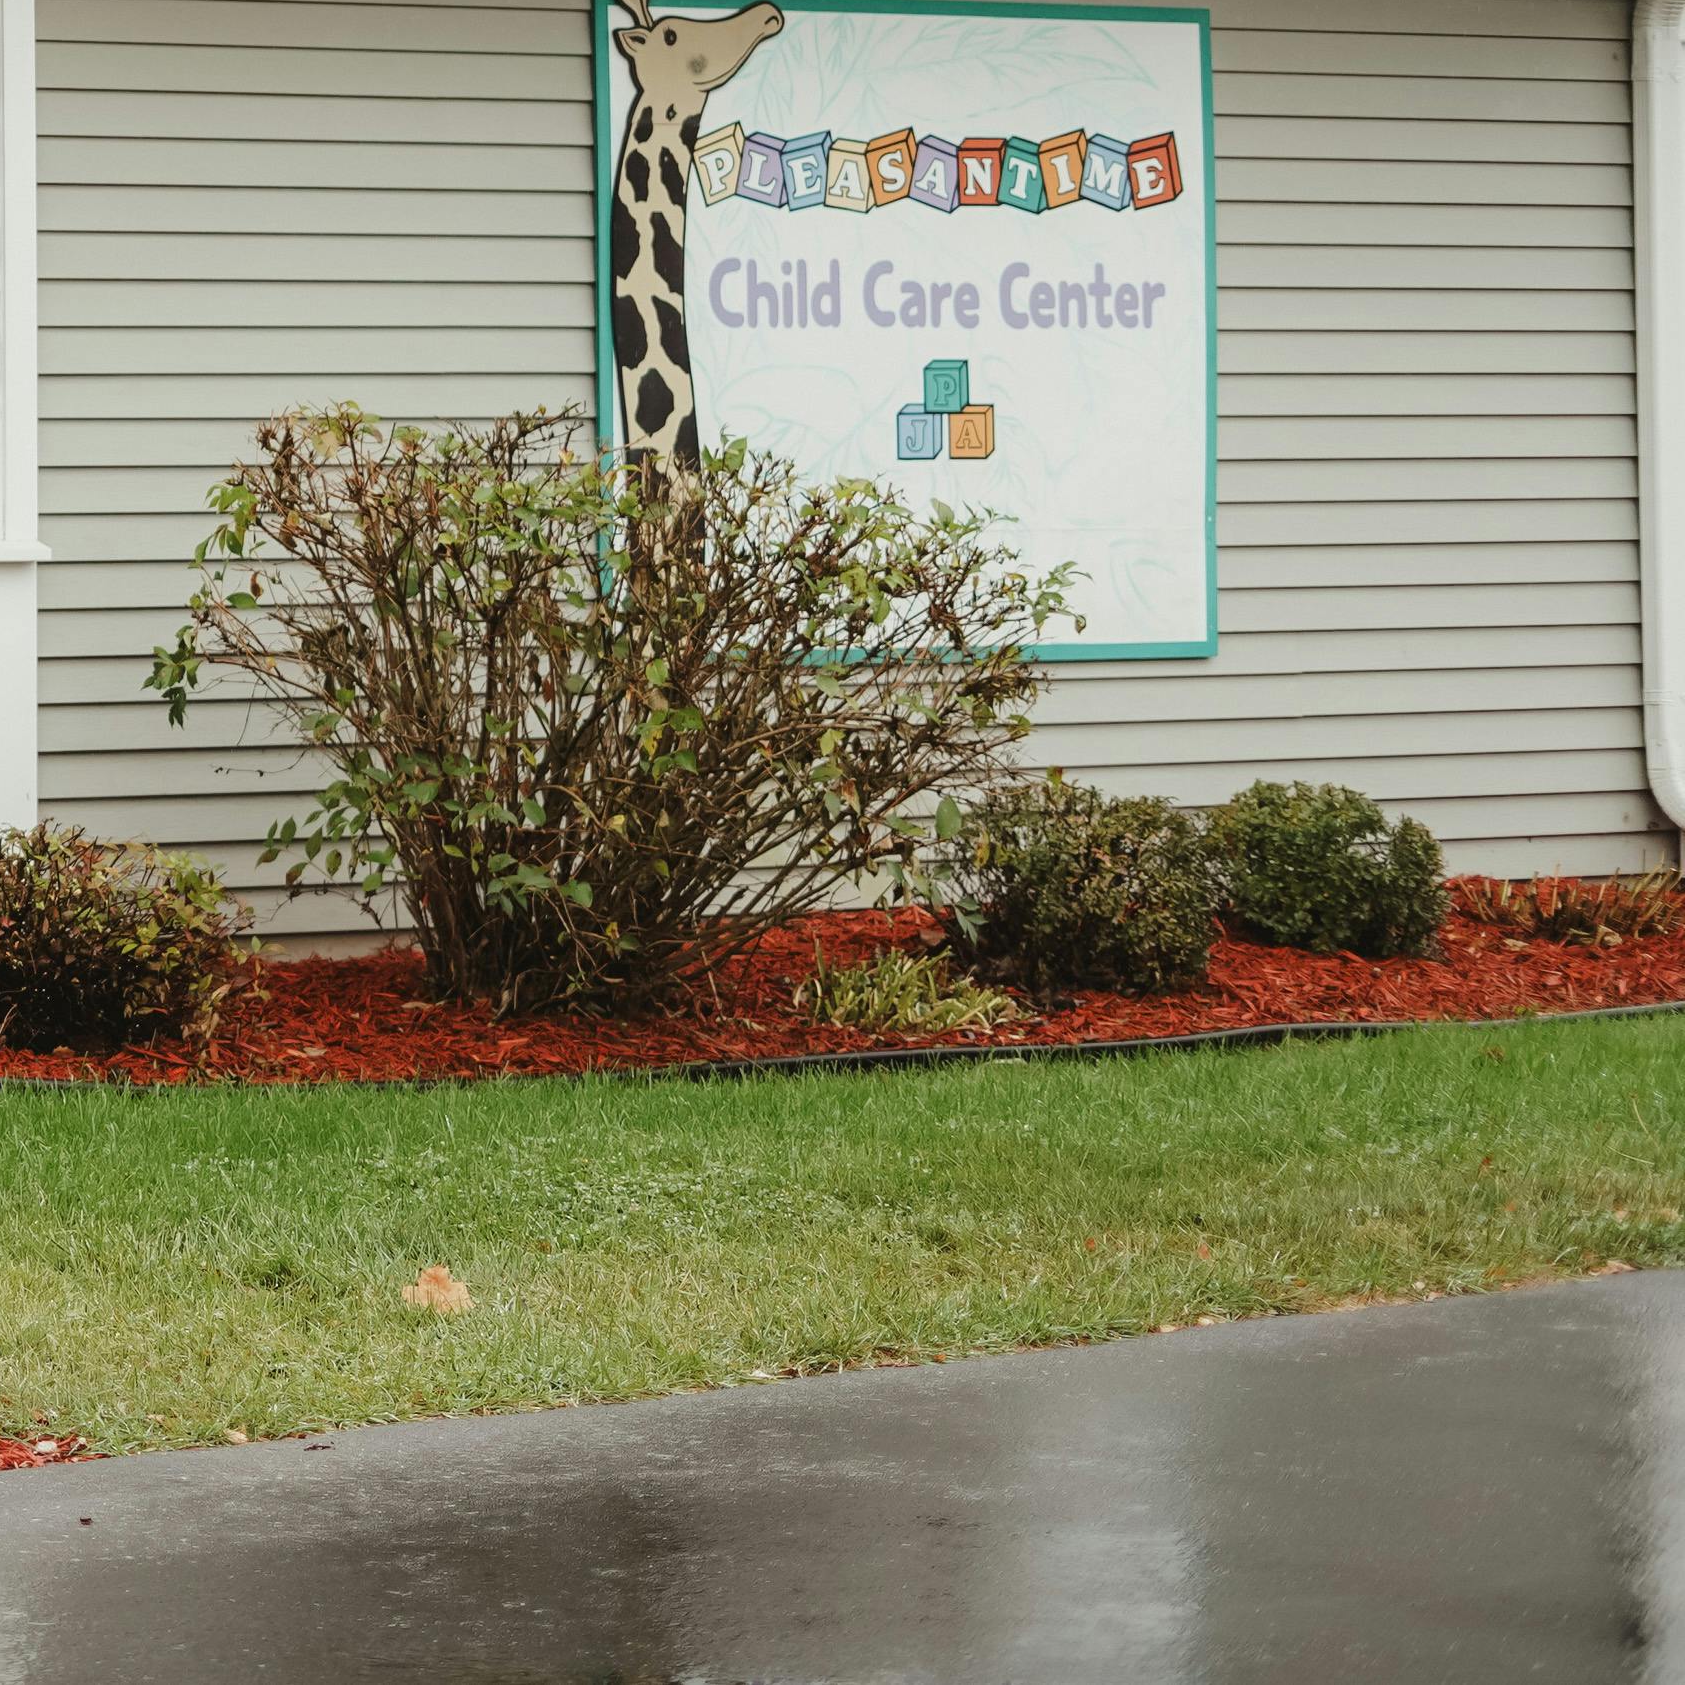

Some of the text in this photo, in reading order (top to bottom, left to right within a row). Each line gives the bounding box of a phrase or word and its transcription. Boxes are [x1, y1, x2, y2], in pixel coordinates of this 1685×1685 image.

[698, 146, 1168, 202] PLEASANTIME
[708, 257, 1166, 329] Child Care Center
[931, 372, 958, 407] P
[905, 418, 983, 453] J A
